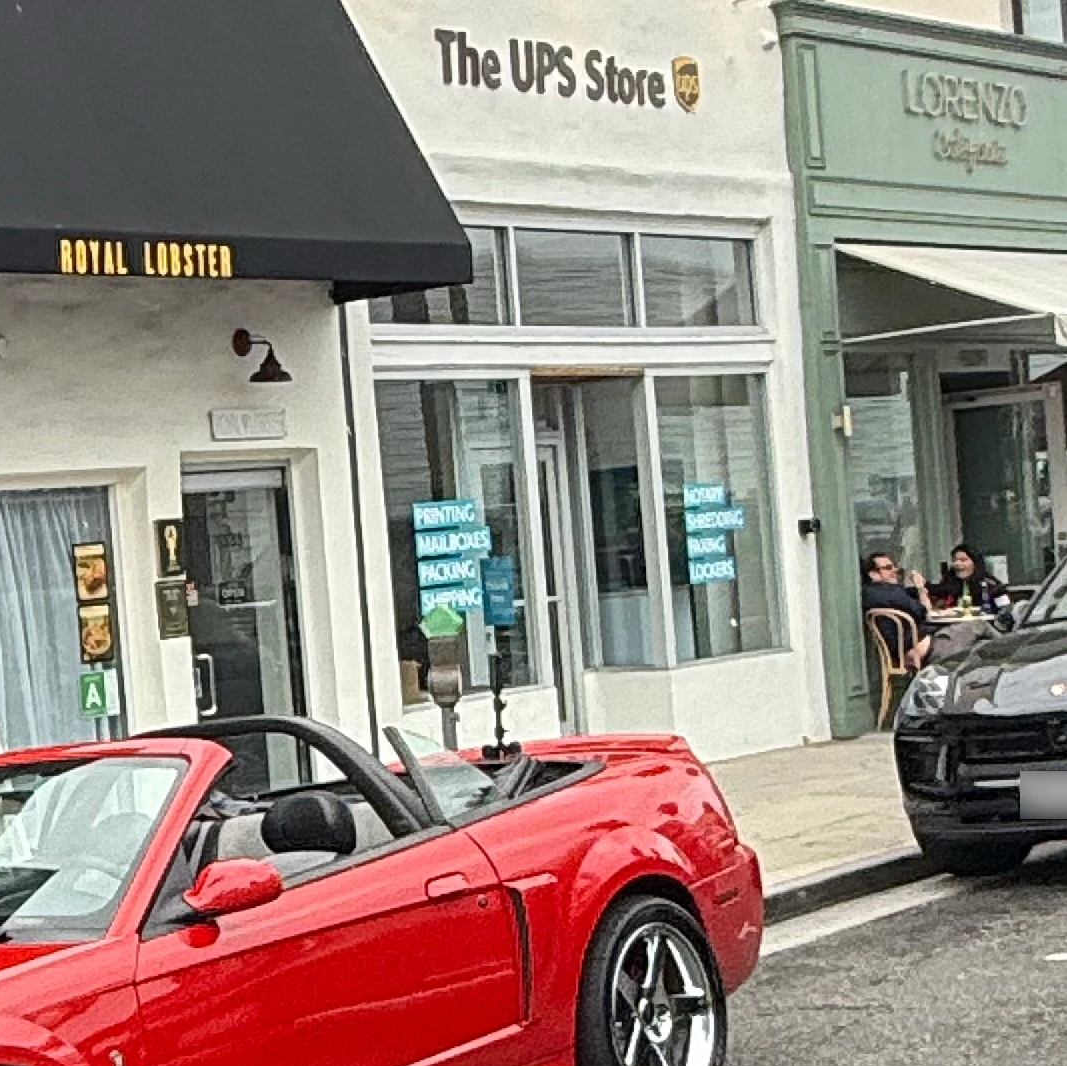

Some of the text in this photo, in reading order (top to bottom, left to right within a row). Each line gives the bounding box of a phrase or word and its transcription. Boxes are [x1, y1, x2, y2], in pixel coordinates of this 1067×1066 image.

[434, 28, 666, 108] The UPS Store
[904, 69, 1027, 128] LORENZO
[59, 239, 233, 277] ROYAL LOBSTER
[415, 503, 475, 525] PRINTING
[687, 509, 744, 528] SHREDDING
[418, 530, 489, 553] MAILBOXES
[420, 559, 476, 582] PACKING
[691, 560, 735, 579] LOCKERS
[85, 681, 103, 709] A
